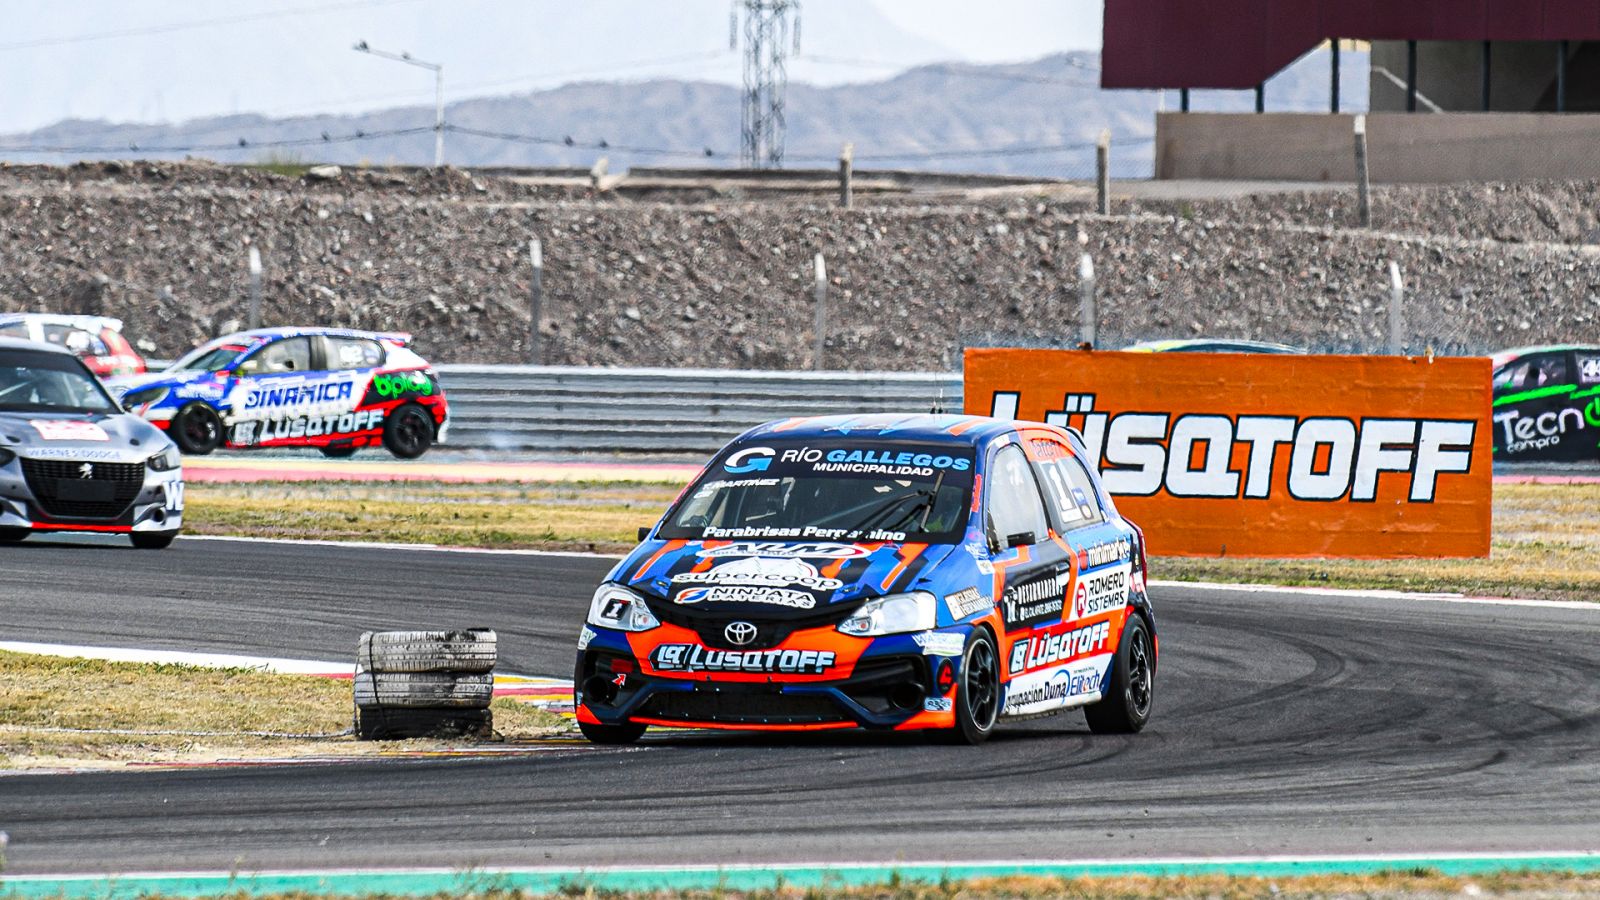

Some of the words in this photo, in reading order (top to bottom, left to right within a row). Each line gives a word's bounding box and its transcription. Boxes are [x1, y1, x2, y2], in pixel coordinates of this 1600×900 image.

[990, 391, 1477, 503] ÜSQTOFF
[781, 447, 822, 463] RÍO
[827, 449, 971, 471] GALLEGOS
[813, 462, 934, 476] MUNICIPALIDAD
[702, 526, 801, 538] Parabrisas
[804, 526, 906, 542] Pergaino
[676, 573, 842, 588] supercoop
[1089, 572, 1124, 596] ROMERO
[711, 594, 811, 607] BATERIAS
[713, 588, 811, 601] NINJATA
[1088, 591, 1124, 614] SISTEMAS
[606, 603, 623, 617] 1
[1044, 681, 1067, 701] Duna
